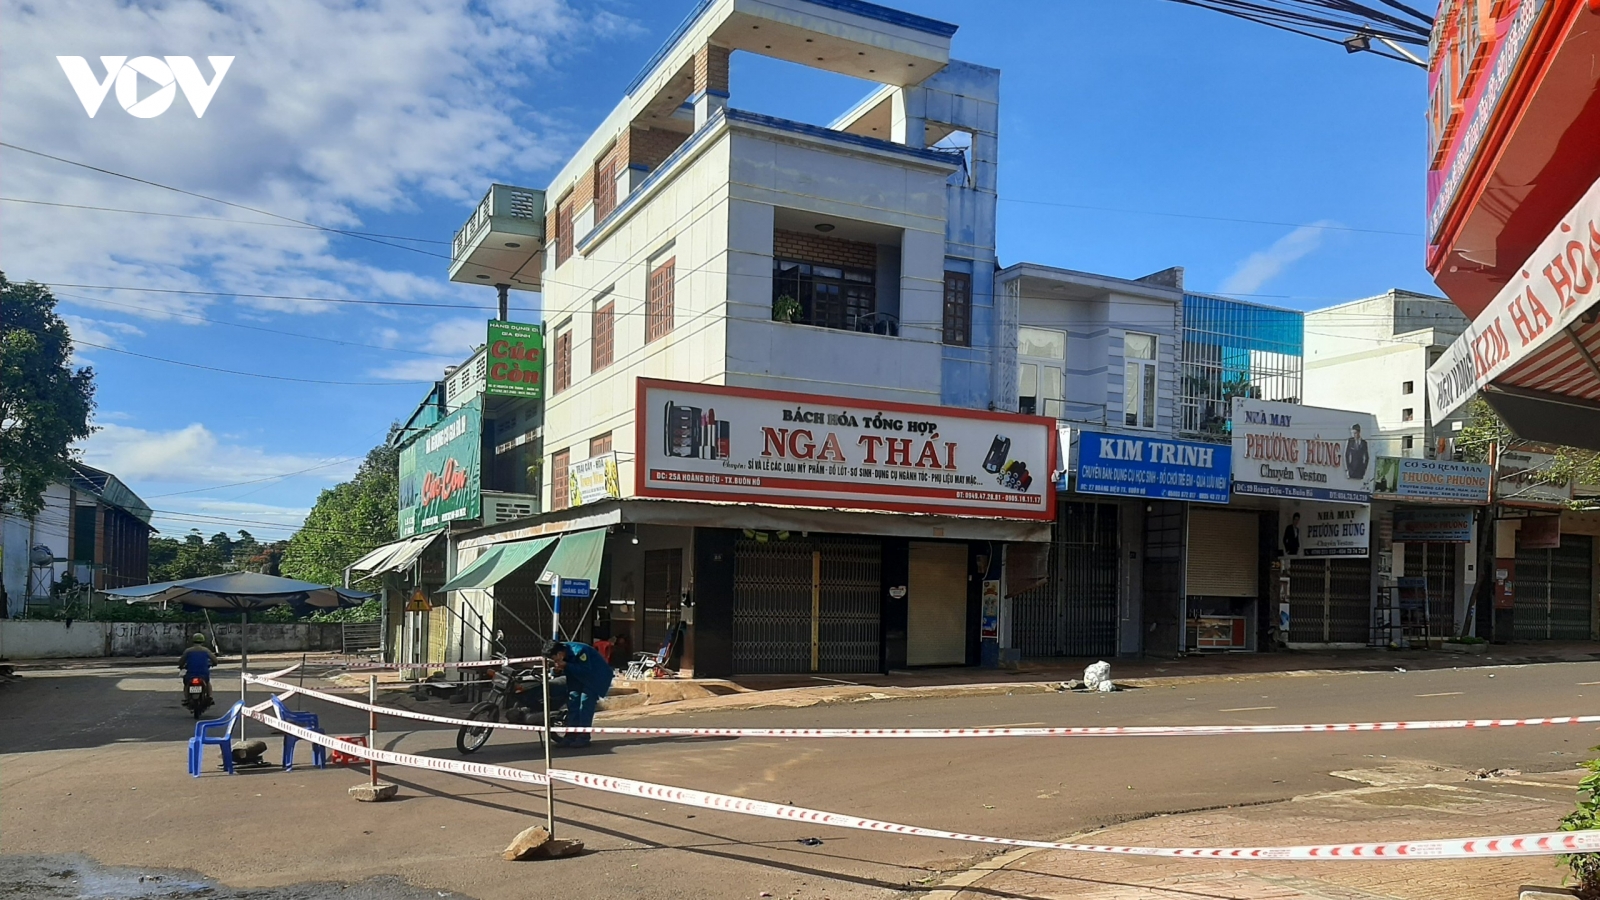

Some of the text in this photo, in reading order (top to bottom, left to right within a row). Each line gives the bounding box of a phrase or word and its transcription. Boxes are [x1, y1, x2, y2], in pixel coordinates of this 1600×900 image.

[1469, 316, 1511, 381] KIM
[1507, 269, 1554, 348] HÀ
[491, 339, 540, 362] Cúc
[490, 362, 540, 384] Còn
[782, 406, 938, 436] BÁCH HÓA TỔNG HỢP
[1269, 412, 1293, 428] MAY
[760, 426, 959, 471] NGA THÁI
[1098, 437, 1214, 469] KIM TRINH
[1244, 431, 1342, 469] PHƯƠNG HÙNG
[669, 473, 682, 481] 25A
[682, 473, 704, 482] HOÀNG
[705, 474, 720, 484] DIỆU
[752, 477, 761, 486] HỒ
[754, 458, 762, 470] VÀ
[770, 460, 782, 472] CÁC
[783, 462, 797, 474] LOẠI
[808, 461, 825, 475] PHẨM
[898, 469, 917, 481] NGÀNH
[942, 472, 954, 485] LIỆU
[954, 474, 965, 485] MAY
[1127, 468, 1135, 484] CỤ
[1135, 469, 1146, 485] HỌC
[1146, 470, 1157, 484] SINH
[1186, 474, 1194, 487] EM
[1260, 463, 1328, 483] Chuyên Veston
[1446, 473, 1486, 487] PHƯƠNG
[1317, 510, 1356, 520] NHÀ MAY
[1307, 522, 1340, 538] PHƯƠNG
